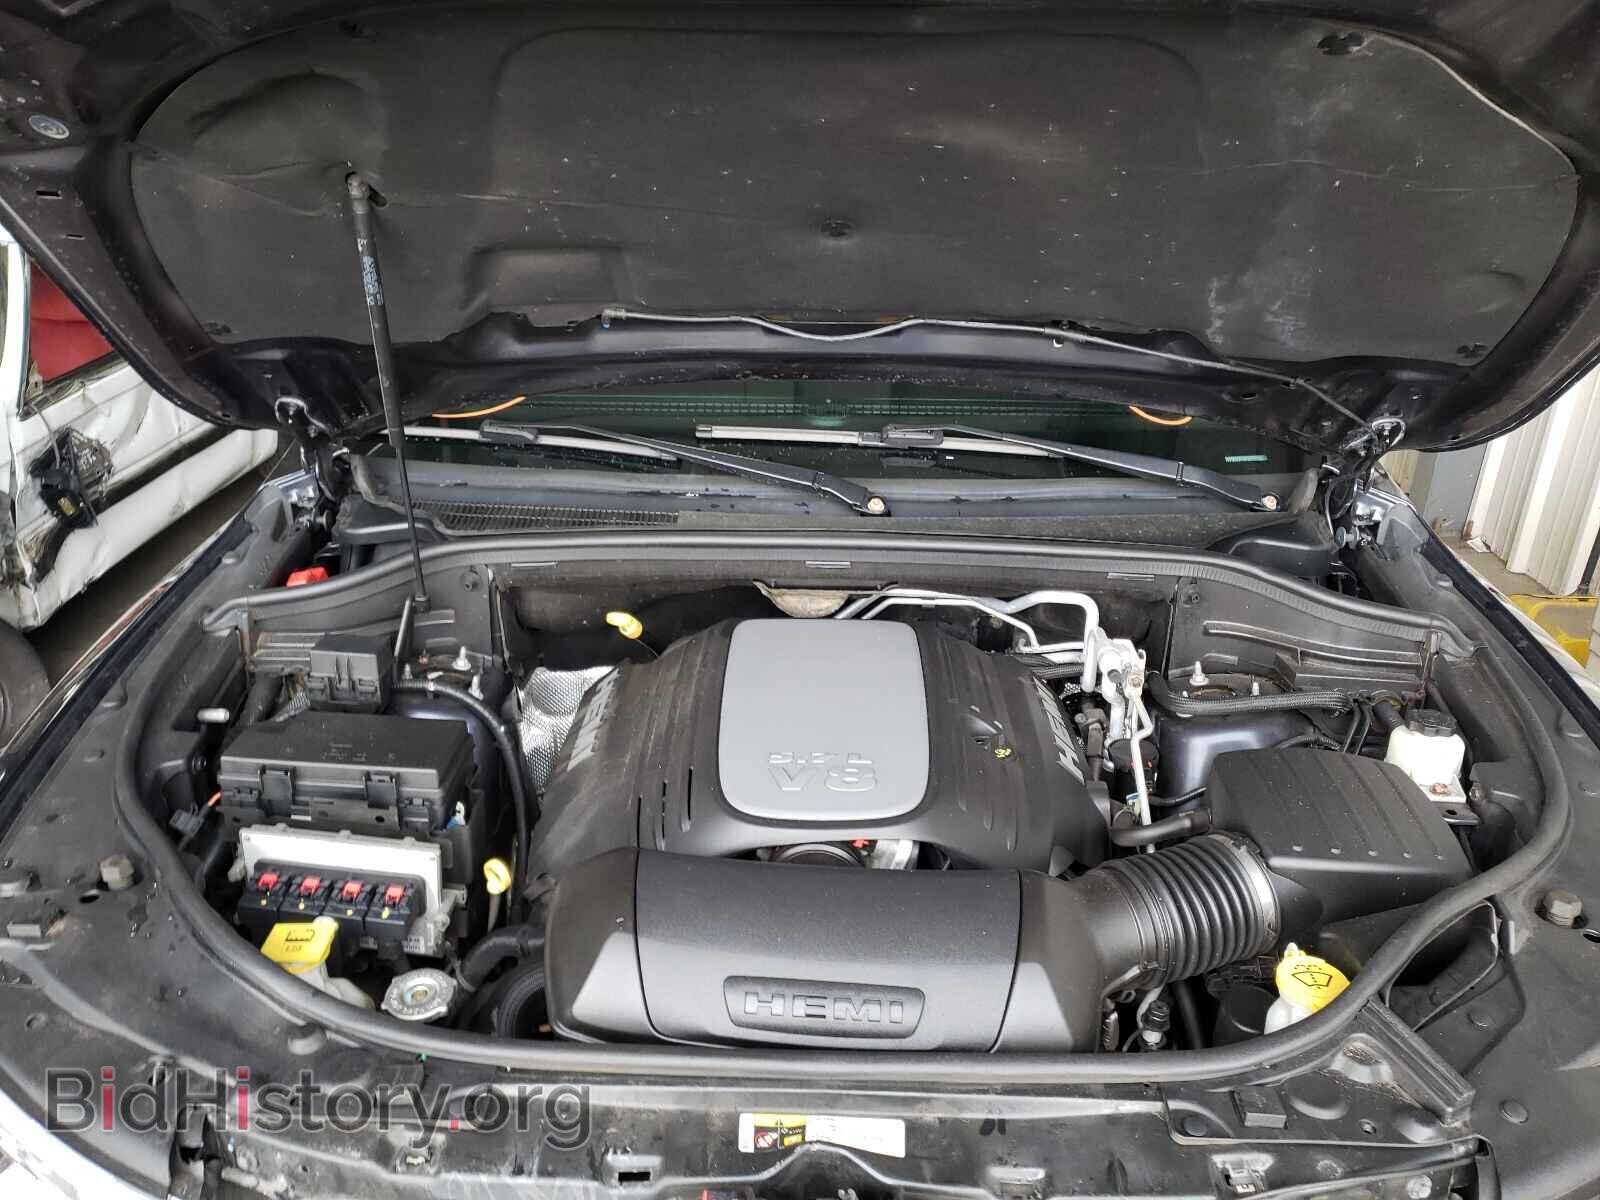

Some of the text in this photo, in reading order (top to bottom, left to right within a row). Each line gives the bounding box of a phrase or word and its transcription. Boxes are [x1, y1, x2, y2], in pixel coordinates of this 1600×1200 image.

[1033, 676, 1085, 786] HEMI
[768, 766, 877, 792] V8
[743, 991, 904, 1024] HEMI
